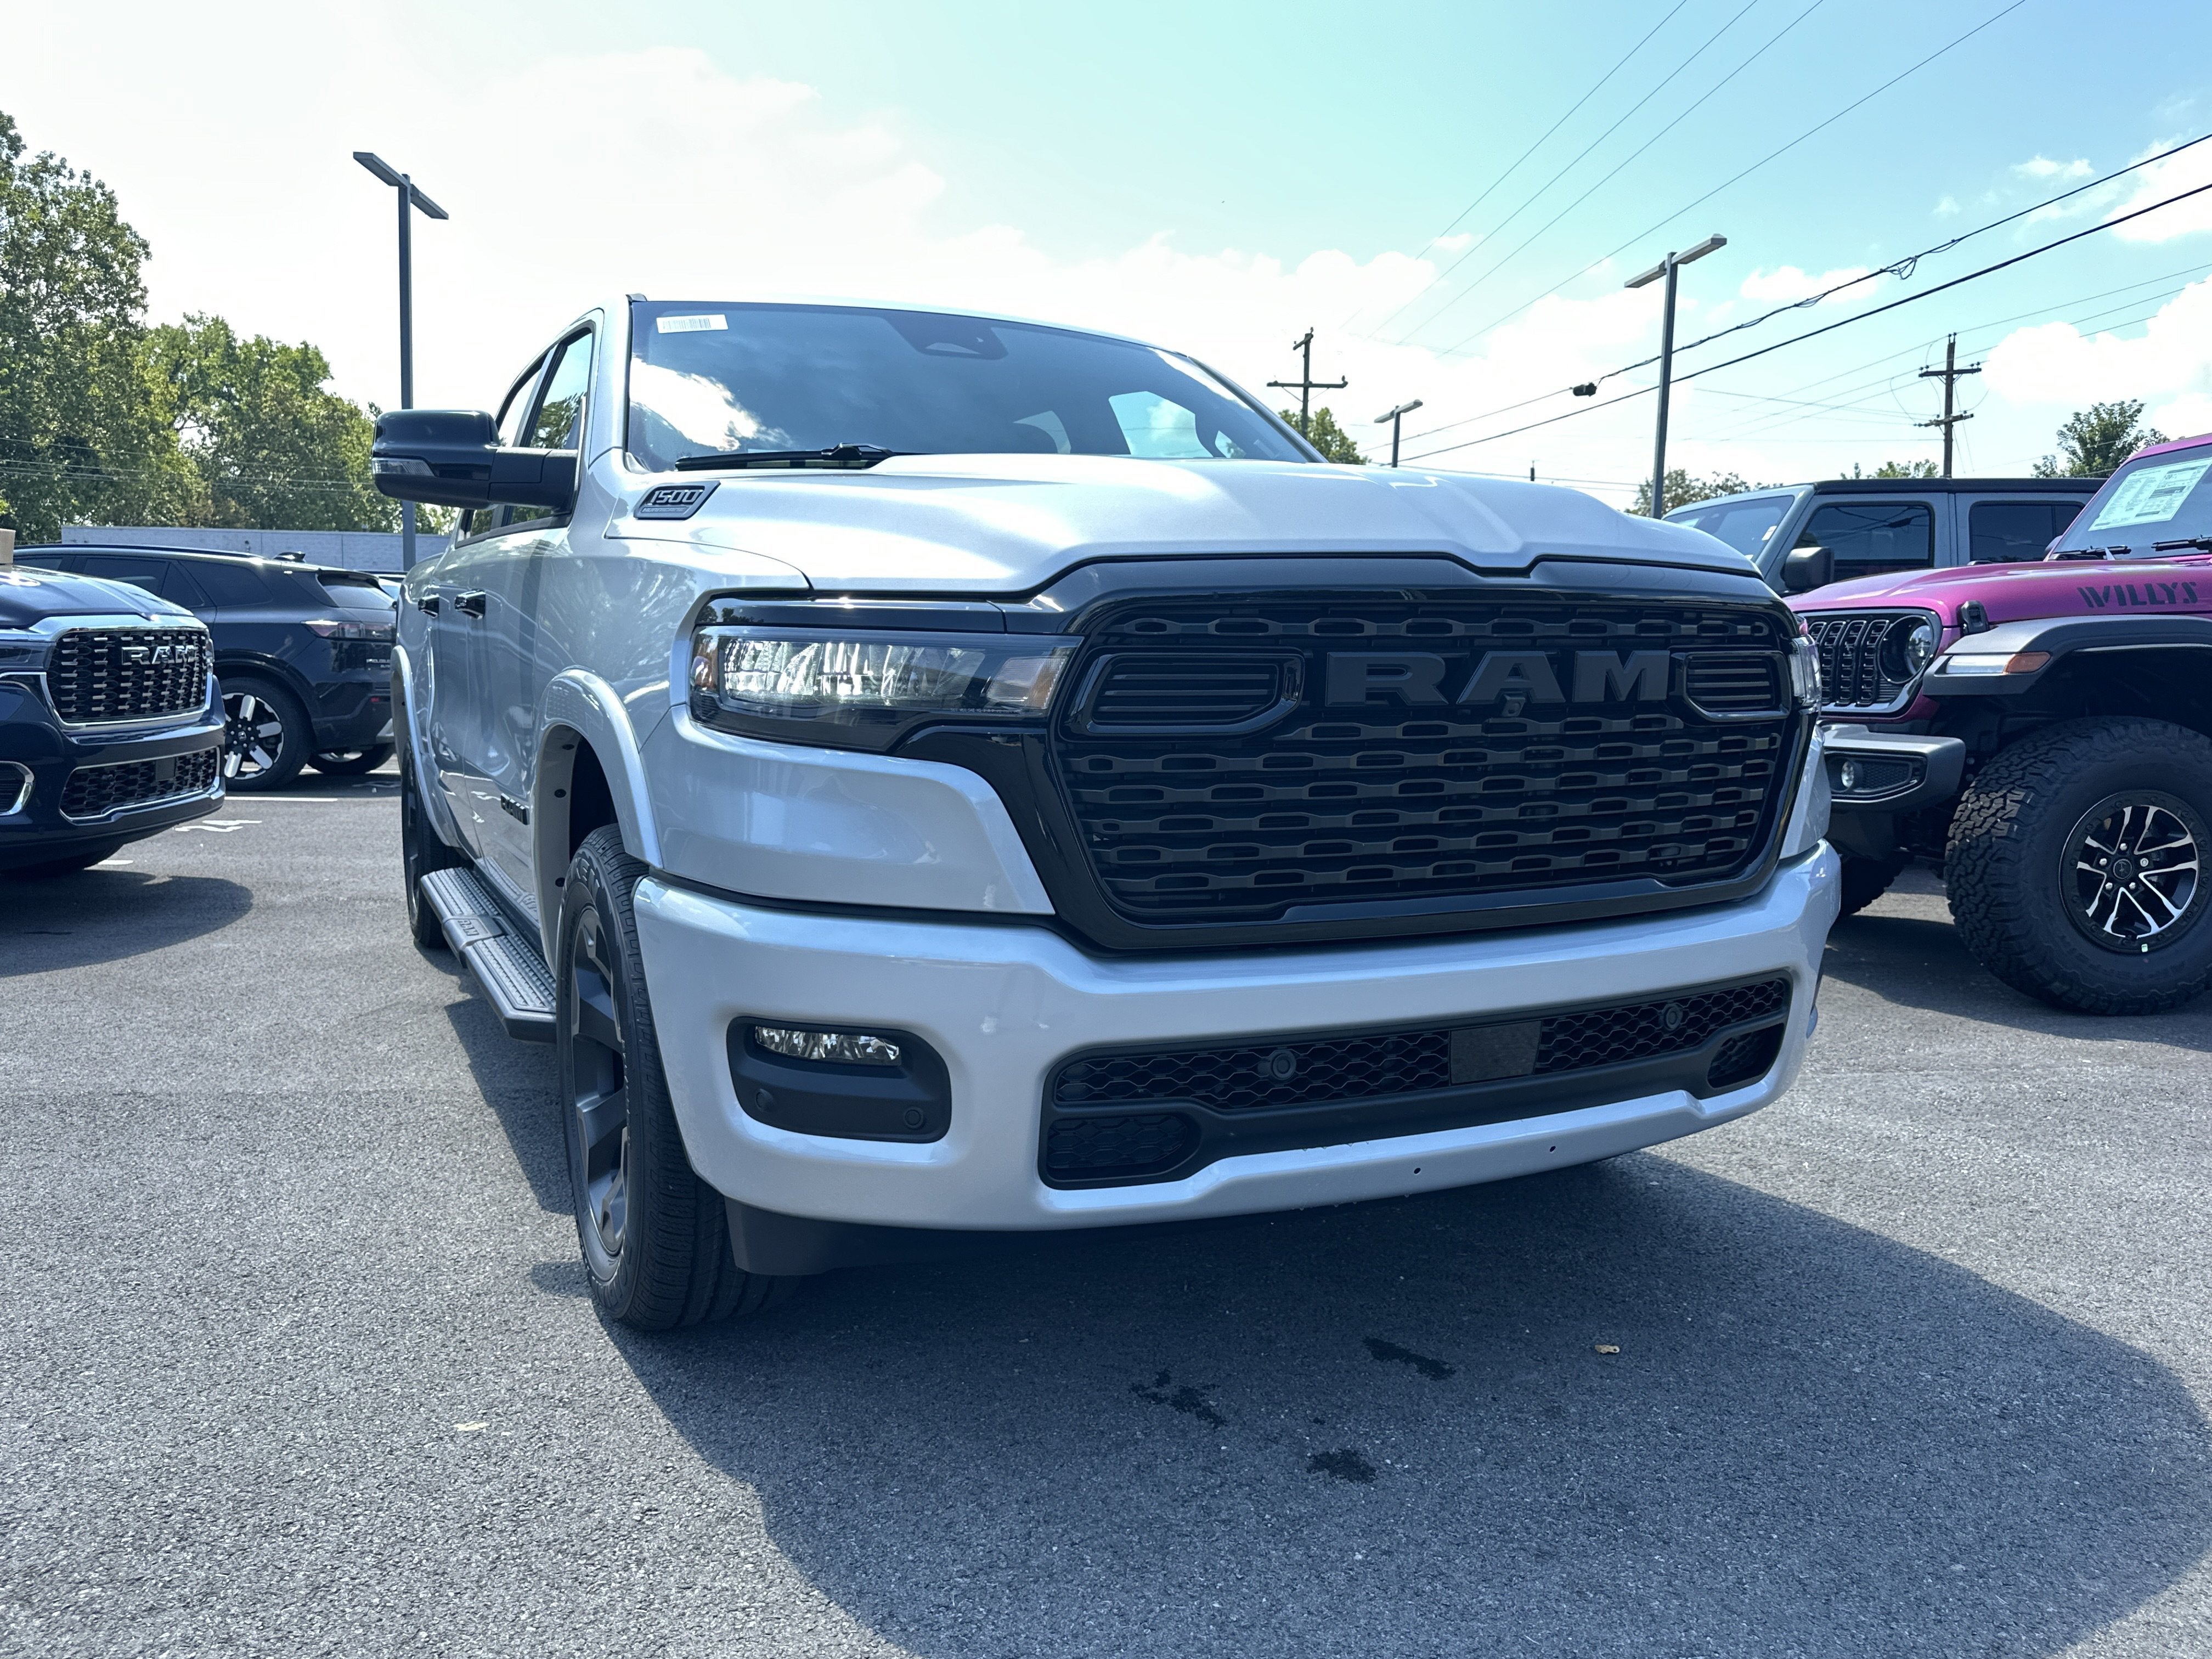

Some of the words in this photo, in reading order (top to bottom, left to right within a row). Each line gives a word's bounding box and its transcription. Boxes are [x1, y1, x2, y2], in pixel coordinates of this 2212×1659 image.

[650, 489, 701, 503] 1500
[2077, 582, 2198, 608] WILLYS
[121, 645, 195, 665] RAM
[1325, 650, 1671, 707] RAM
